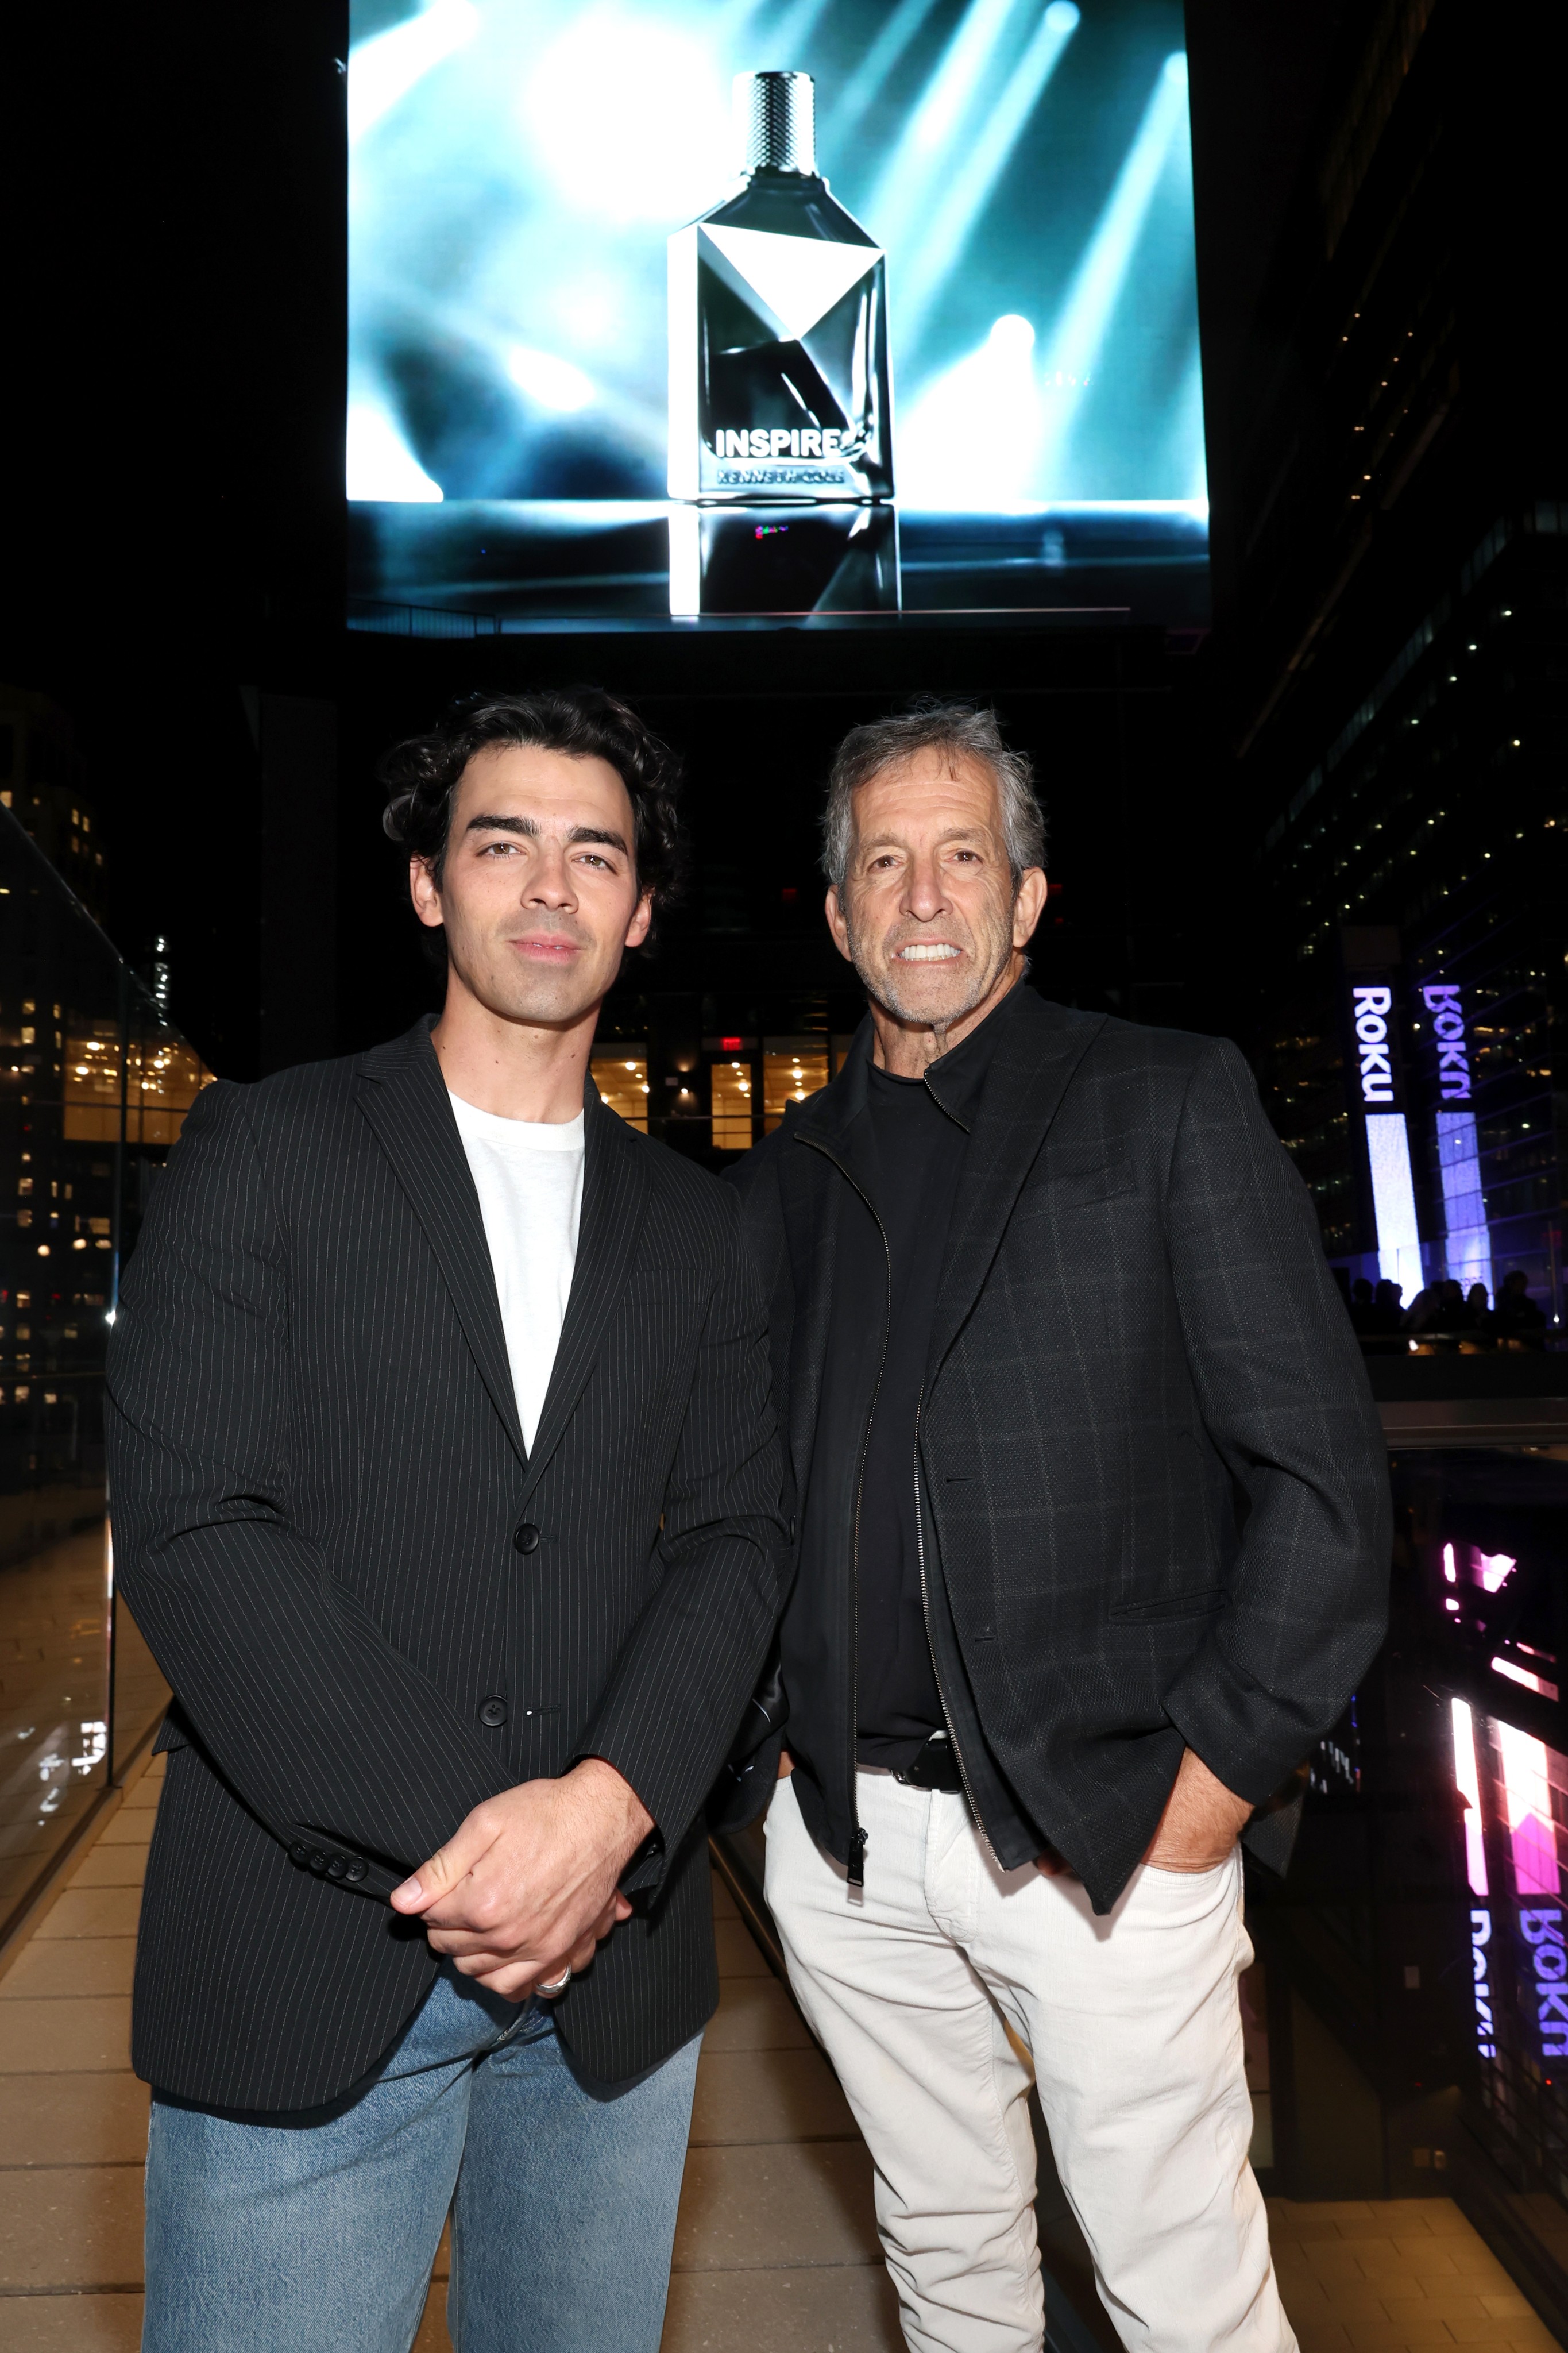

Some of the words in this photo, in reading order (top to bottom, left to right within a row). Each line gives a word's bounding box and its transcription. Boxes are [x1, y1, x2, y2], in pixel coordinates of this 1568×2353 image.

[716, 429, 841, 457] INSPIRE
[717, 469, 797, 485] KENNETH
[802, 469, 845, 484] COLE
